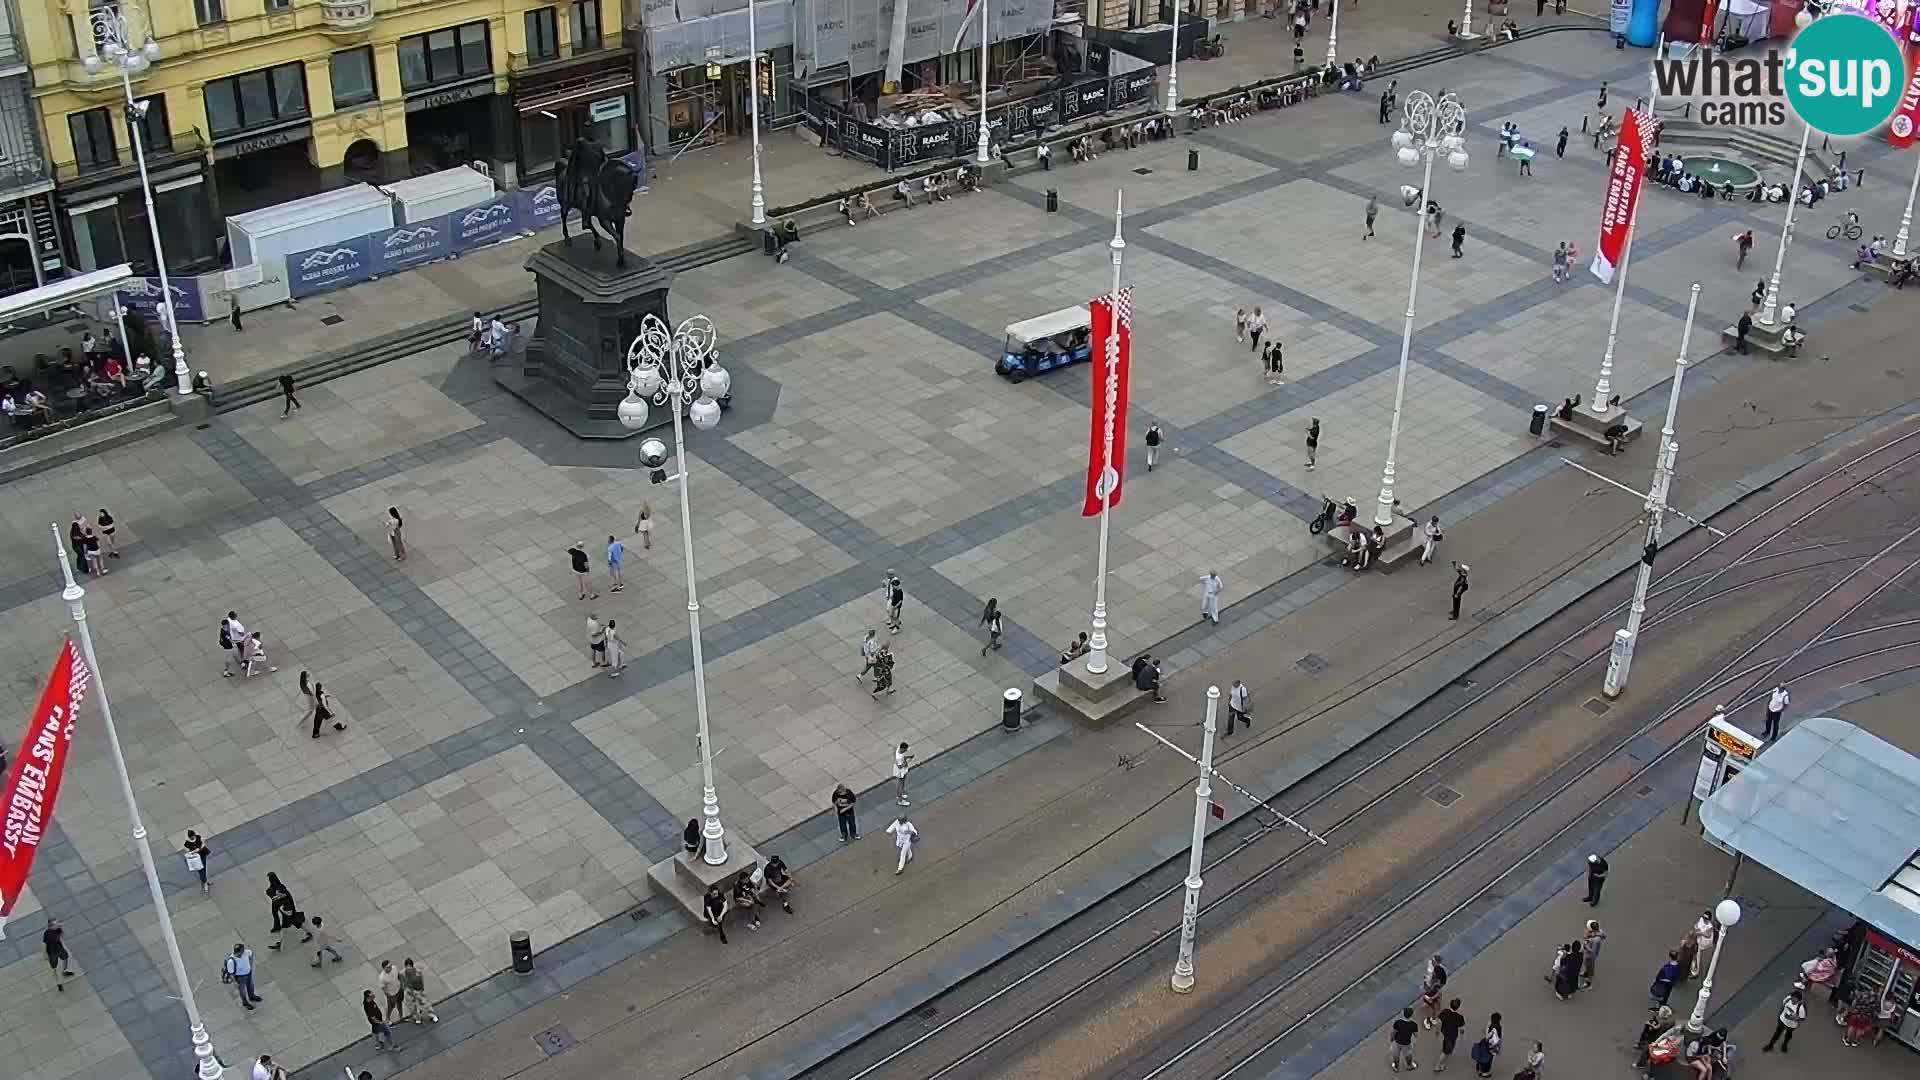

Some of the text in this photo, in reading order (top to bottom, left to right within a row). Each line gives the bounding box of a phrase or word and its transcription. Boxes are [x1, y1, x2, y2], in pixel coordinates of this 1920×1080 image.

[1602, 144, 1630, 235] FANS EMBASSY
[1616, 164, 1636, 225] CROATIAN
[4, 763, 44, 860] EMBASSY
